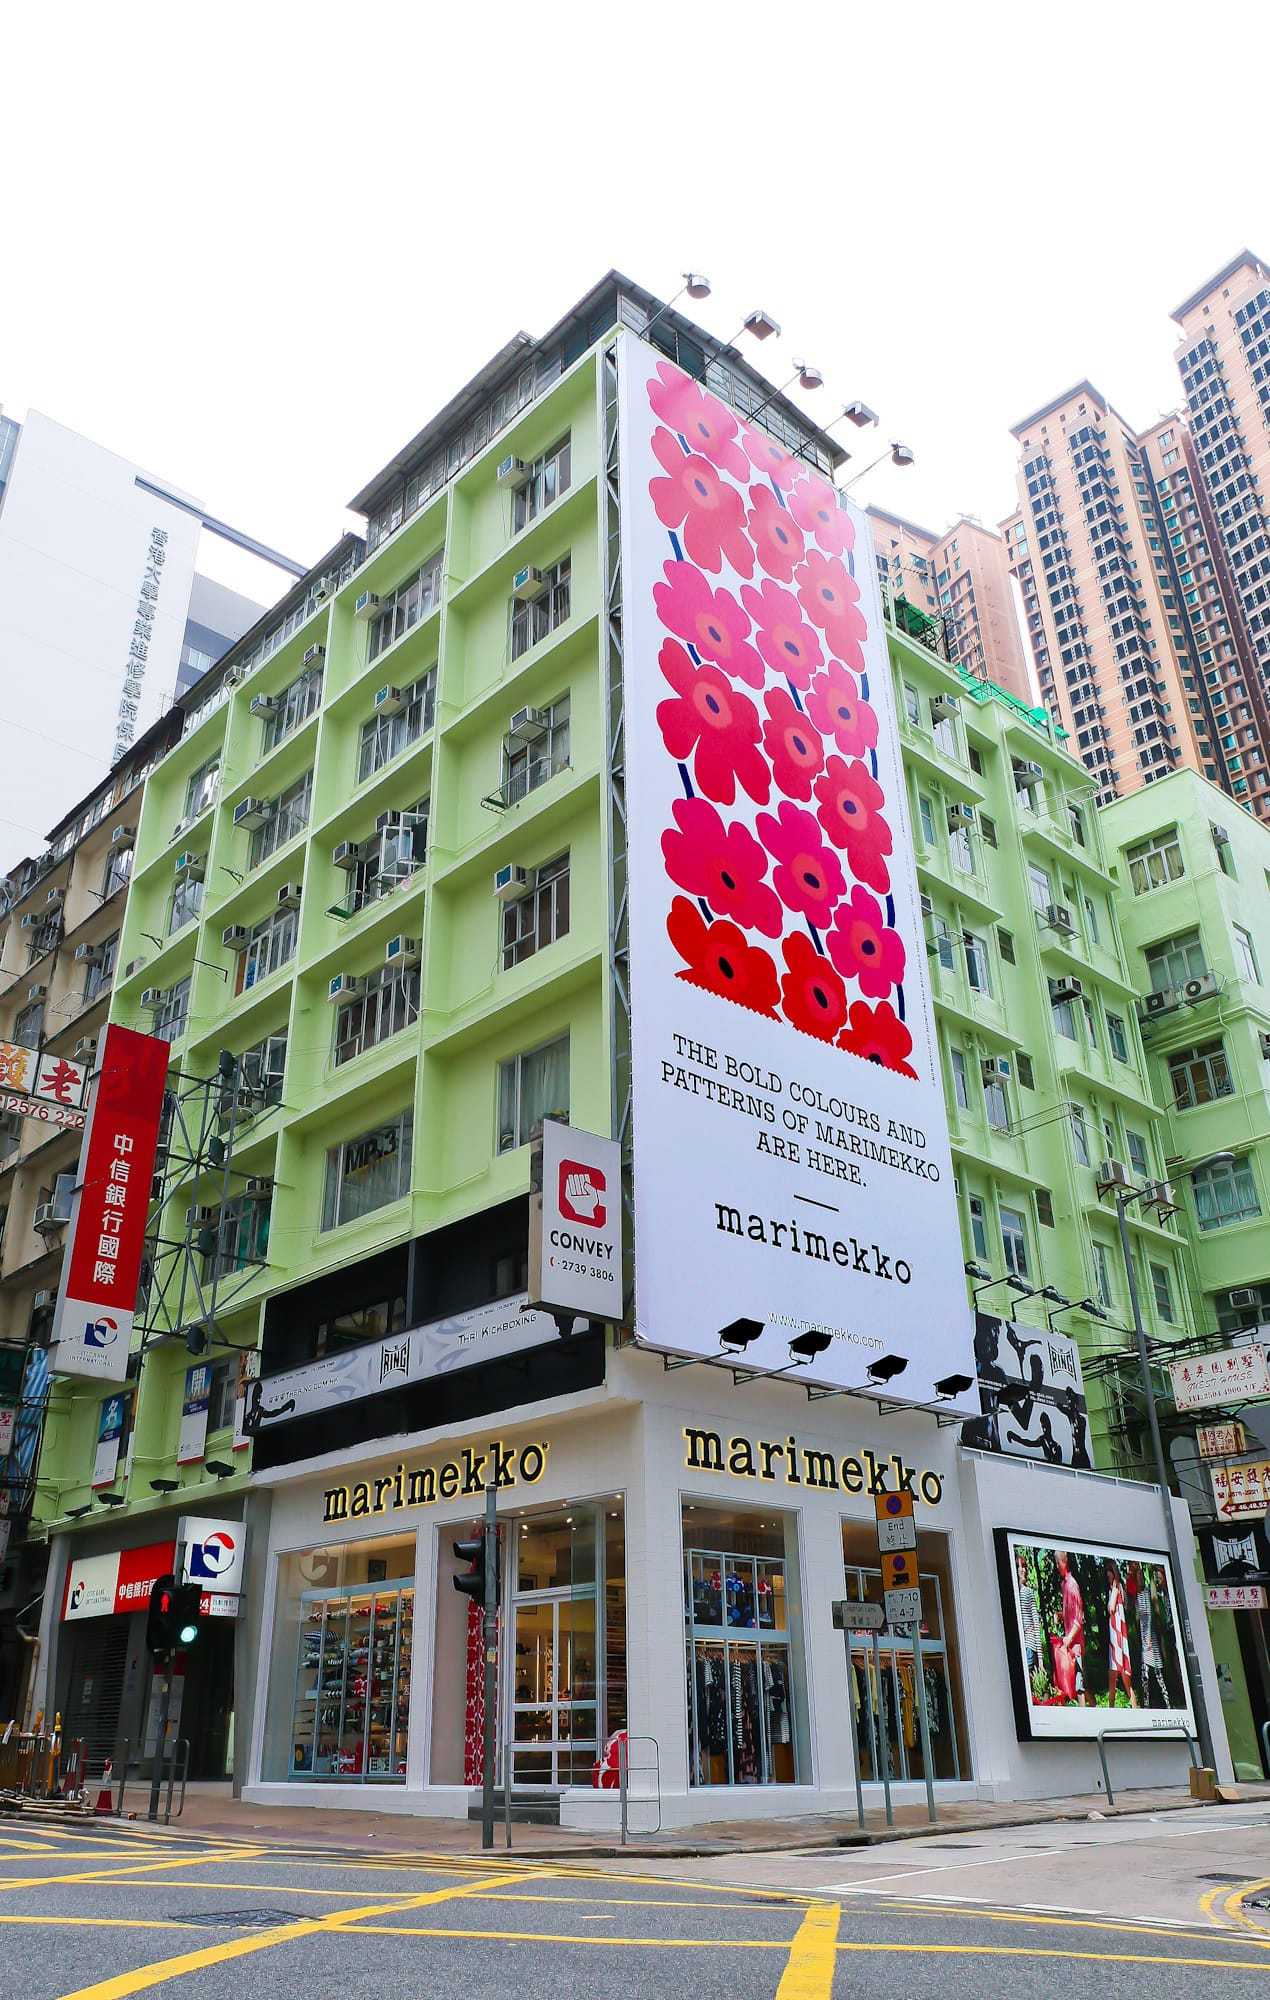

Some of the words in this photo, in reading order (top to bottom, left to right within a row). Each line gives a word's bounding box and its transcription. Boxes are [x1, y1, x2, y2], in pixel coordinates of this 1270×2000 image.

[673, 1033, 718, 1070] THE
[724, 1055, 783, 1094] BOLD
[789, 1081, 881, 1133] COLOURS
[886, 1118, 926, 1149] AND
[8, 1097, 49, 1120] 2576
[661, 1060, 776, 1123] PATTERNS
[783, 1109, 809, 1134] OF
[815, 1120, 940, 1182] MARIMEKKO
[756, 1130, 800, 1163] ARE
[807, 1148, 868, 1187] HERE.
[92, 1133, 134, 1285] 中信銀行國際
[550, 1230, 614, 1260] CONVEY
[715, 1203, 912, 1284] marimekko
[590, 1267, 614, 1282] 3806
[384, 1345, 408, 1373] RING
[1052, 1350, 1074, 1376] RING
[1187, 1378, 1217, 1393] GUEST
[1220, 1370, 1254, 1384] HOUSE
[685, 1428, 942, 1504] marimekko
[323, 1441, 544, 1522] marimekko
[888, 1520, 904, 1531] End
[899, 1592, 919, 1603] 7-10
[899, 1607, 915, 1617] 4-7
[1151, 1717, 1191, 1728] marimekko
